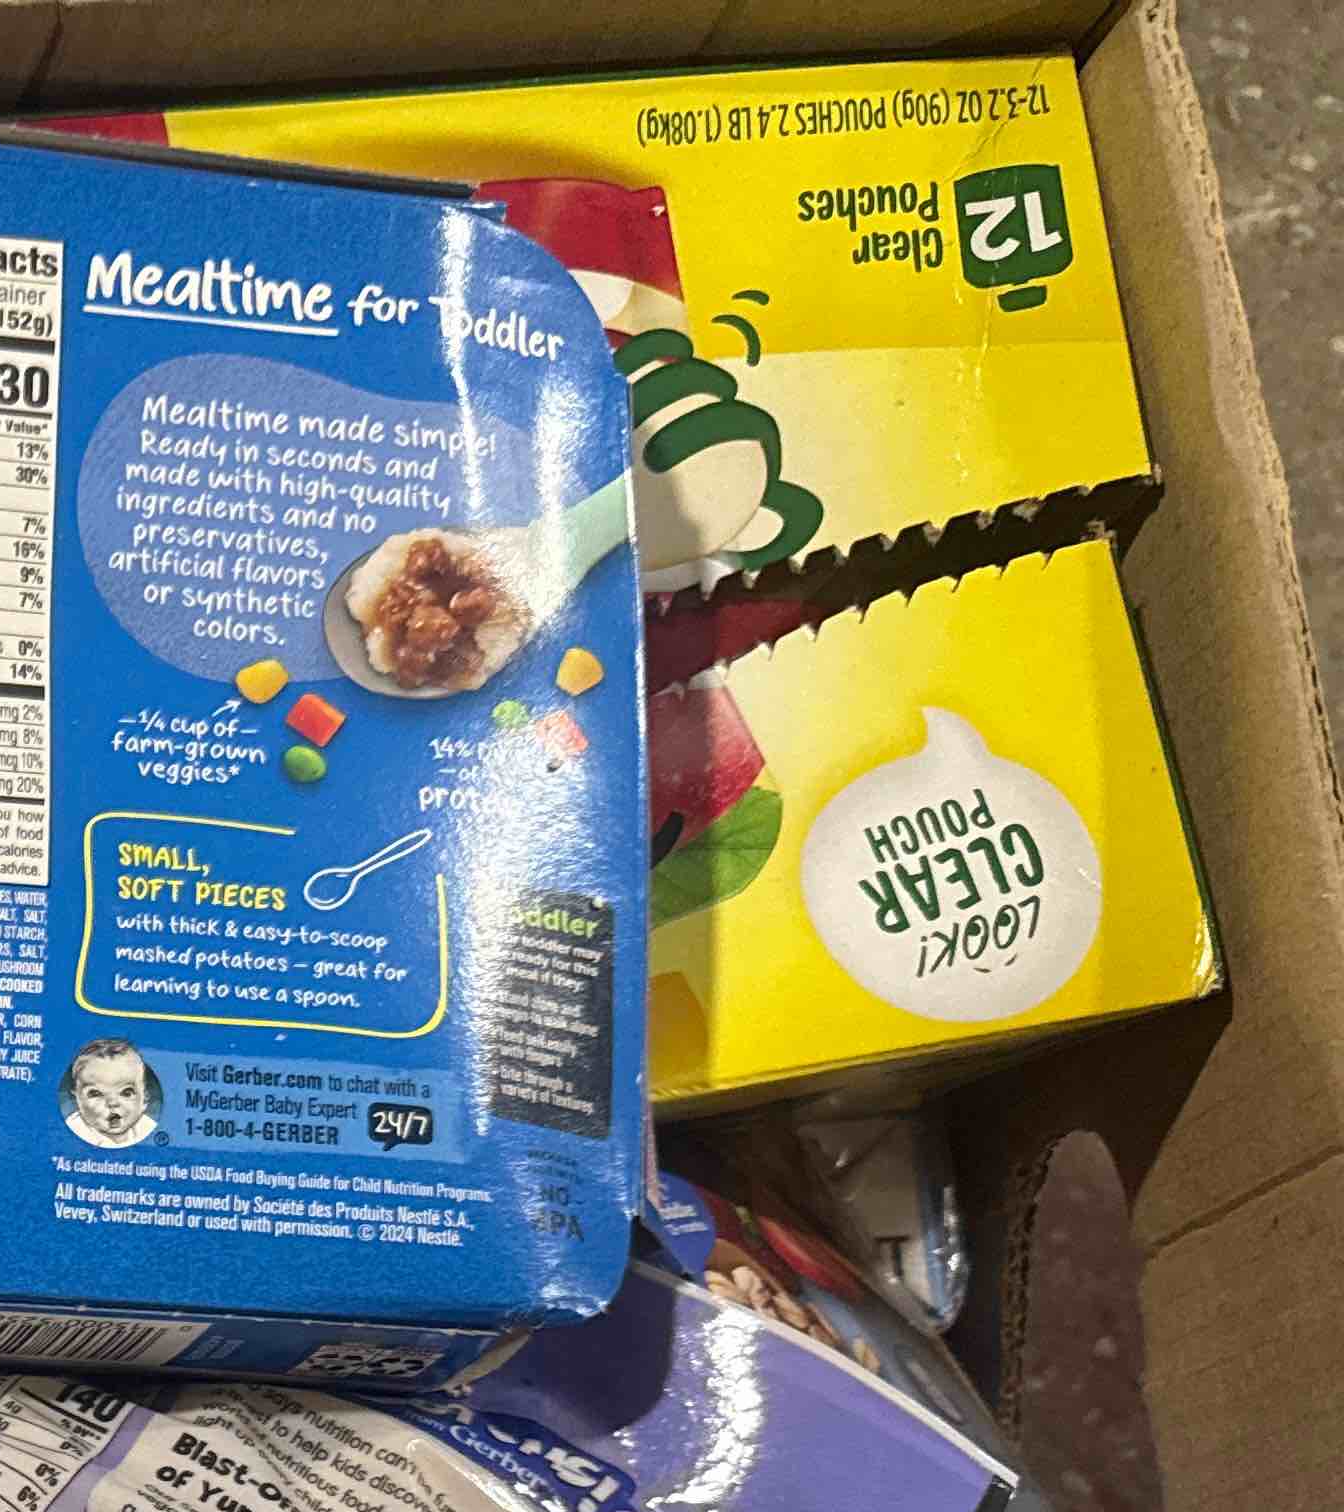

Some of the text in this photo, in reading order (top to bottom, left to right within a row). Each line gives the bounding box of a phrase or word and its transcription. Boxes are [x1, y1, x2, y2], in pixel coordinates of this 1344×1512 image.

[635, 84, 1051, 147] 12-3.2 OZ (90g) POUCHES 2.4 LB (1.08kg)
[797, 181, 939, 232] Pouches
[963, 191, 1062, 262] 12
[851, 227, 945, 273] Clear
[86, 251, 564, 362] Mealtime for Toddler
[142, 394, 496, 460] Mealtime made simple!
[141, 428, 438, 481] Ready in seconds and
[117, 487, 376, 533] ingredients and no
[125, 462, 451, 517] made with high-quality
[133, 522, 329, 564] preservatives,
[109, 550, 326, 589] artificial flavors
[144, 584, 315, 619] or synthetic
[193, 615, 286, 647] colors.
[112, 730, 267, 766] farm-grown
[863, 788, 995, 863] POUCH
[118, 842, 211, 877] SMALL,
[857, 822, 1045, 935] CLEAR
[118, 877, 287, 911] SOFT PIECES
[185, 1118, 339, 1145] 1-800-4-GERBER
[373, 1108, 429, 1137] 24/7
[155, 1465, 193, 1491] of
